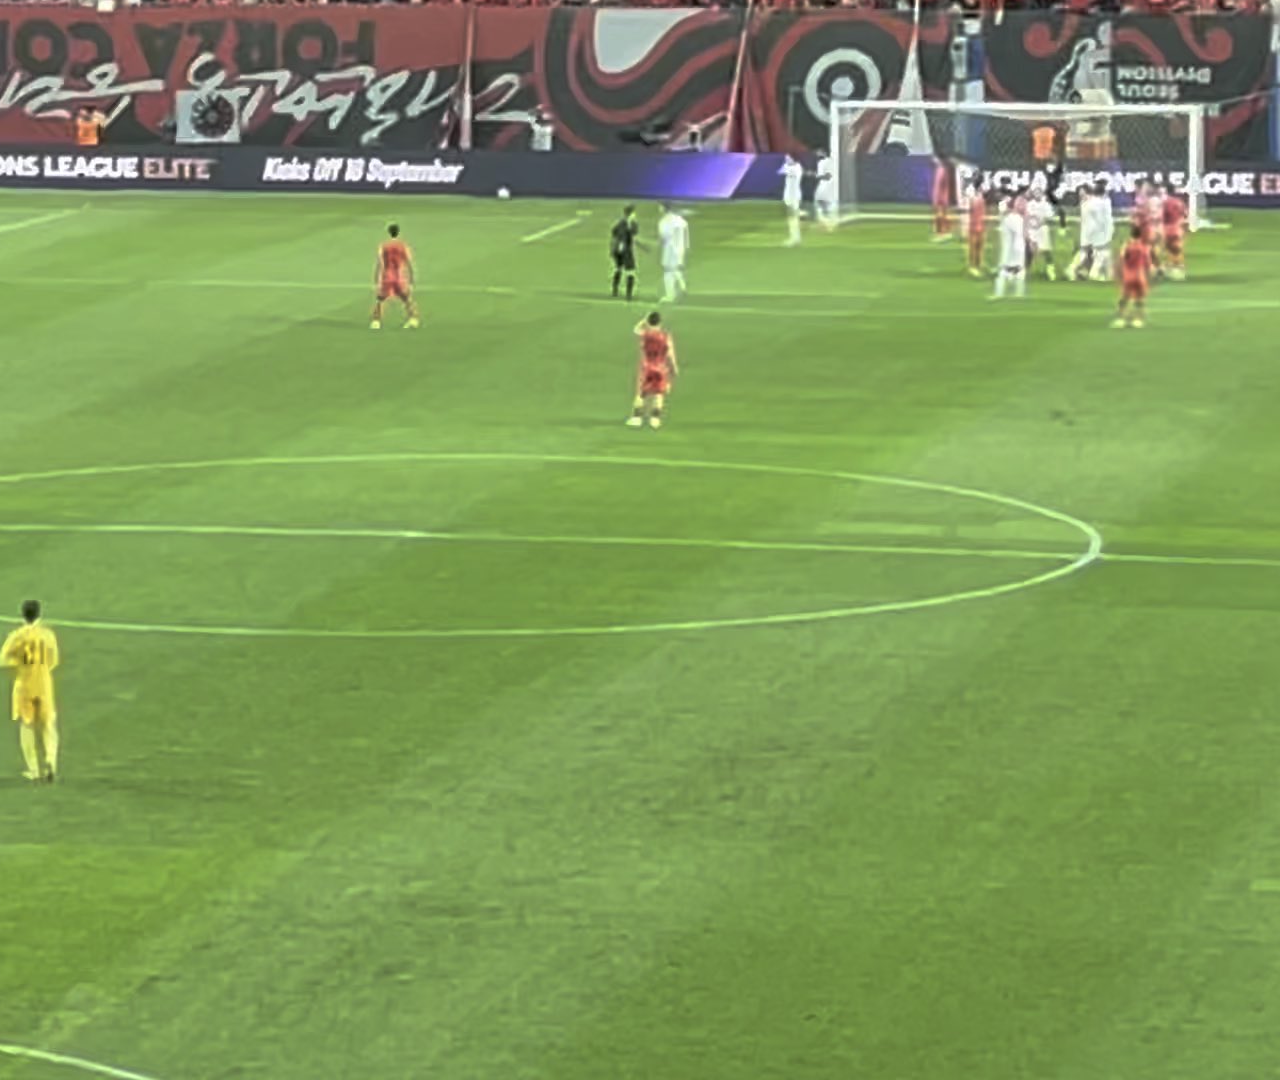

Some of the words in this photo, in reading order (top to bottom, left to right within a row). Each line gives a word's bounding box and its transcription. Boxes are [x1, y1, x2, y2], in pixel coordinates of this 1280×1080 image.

[44, 156, 139, 179] LEAGUE
[143, 158, 212, 180] ELITE
[262, 156, 311, 181] Kicks
[313, 157, 344, 181] Off
[366, 158, 465, 189] September
